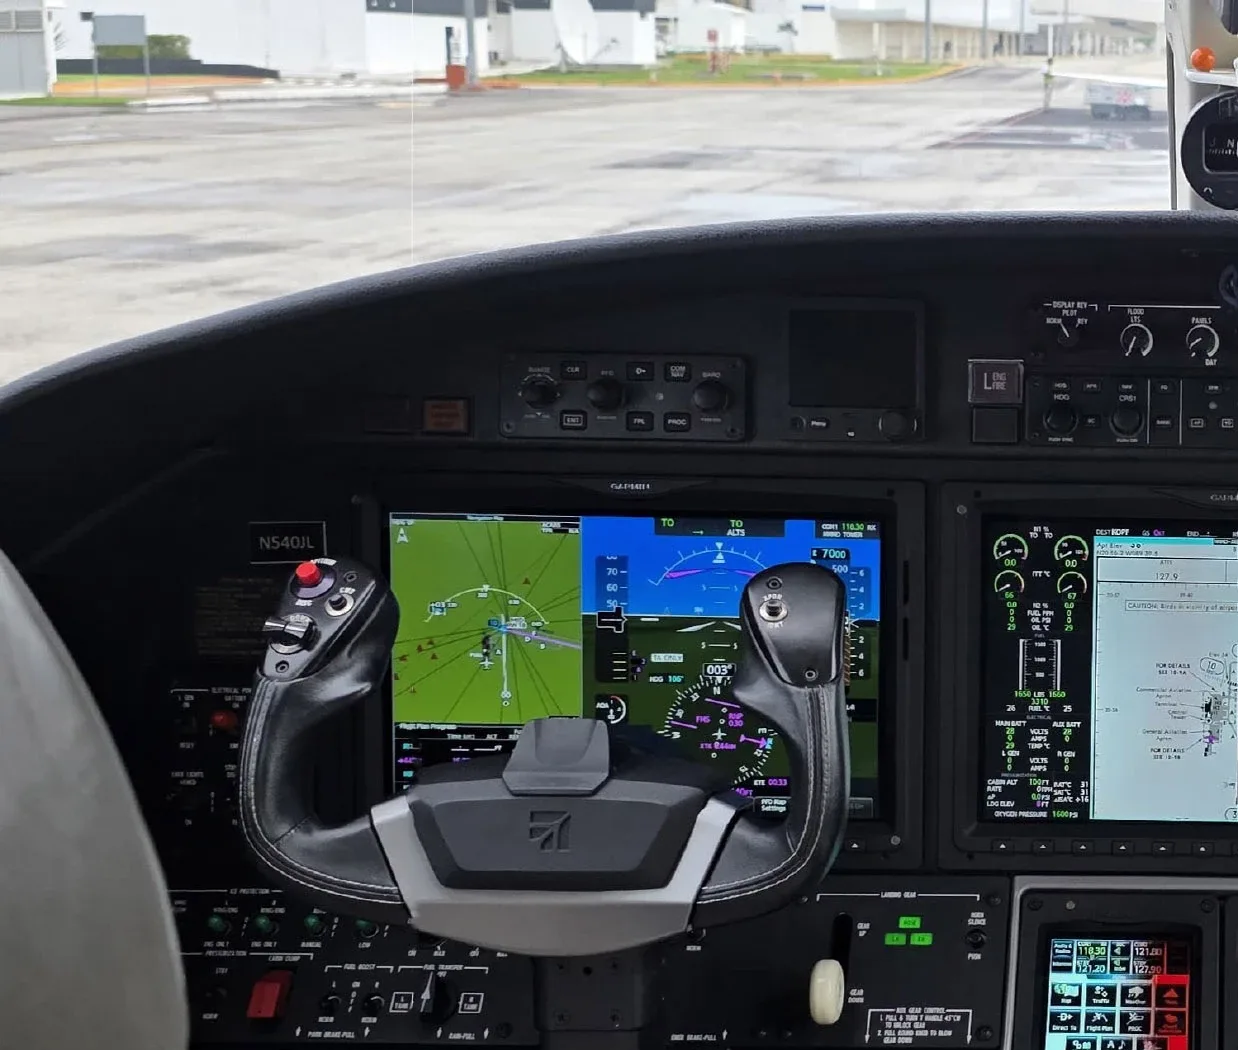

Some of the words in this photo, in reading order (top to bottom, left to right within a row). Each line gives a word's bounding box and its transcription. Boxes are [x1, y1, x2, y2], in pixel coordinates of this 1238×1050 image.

[660, 519, 674, 527] TO
[729, 520, 743, 528] TO
[727, 529, 746, 537] ALTS
[260, 536, 316, 550] N540JL
[606, 568, 618, 576] 70
[1155, 573, 1178, 581] 127.9
[606, 584, 618, 592] 60
